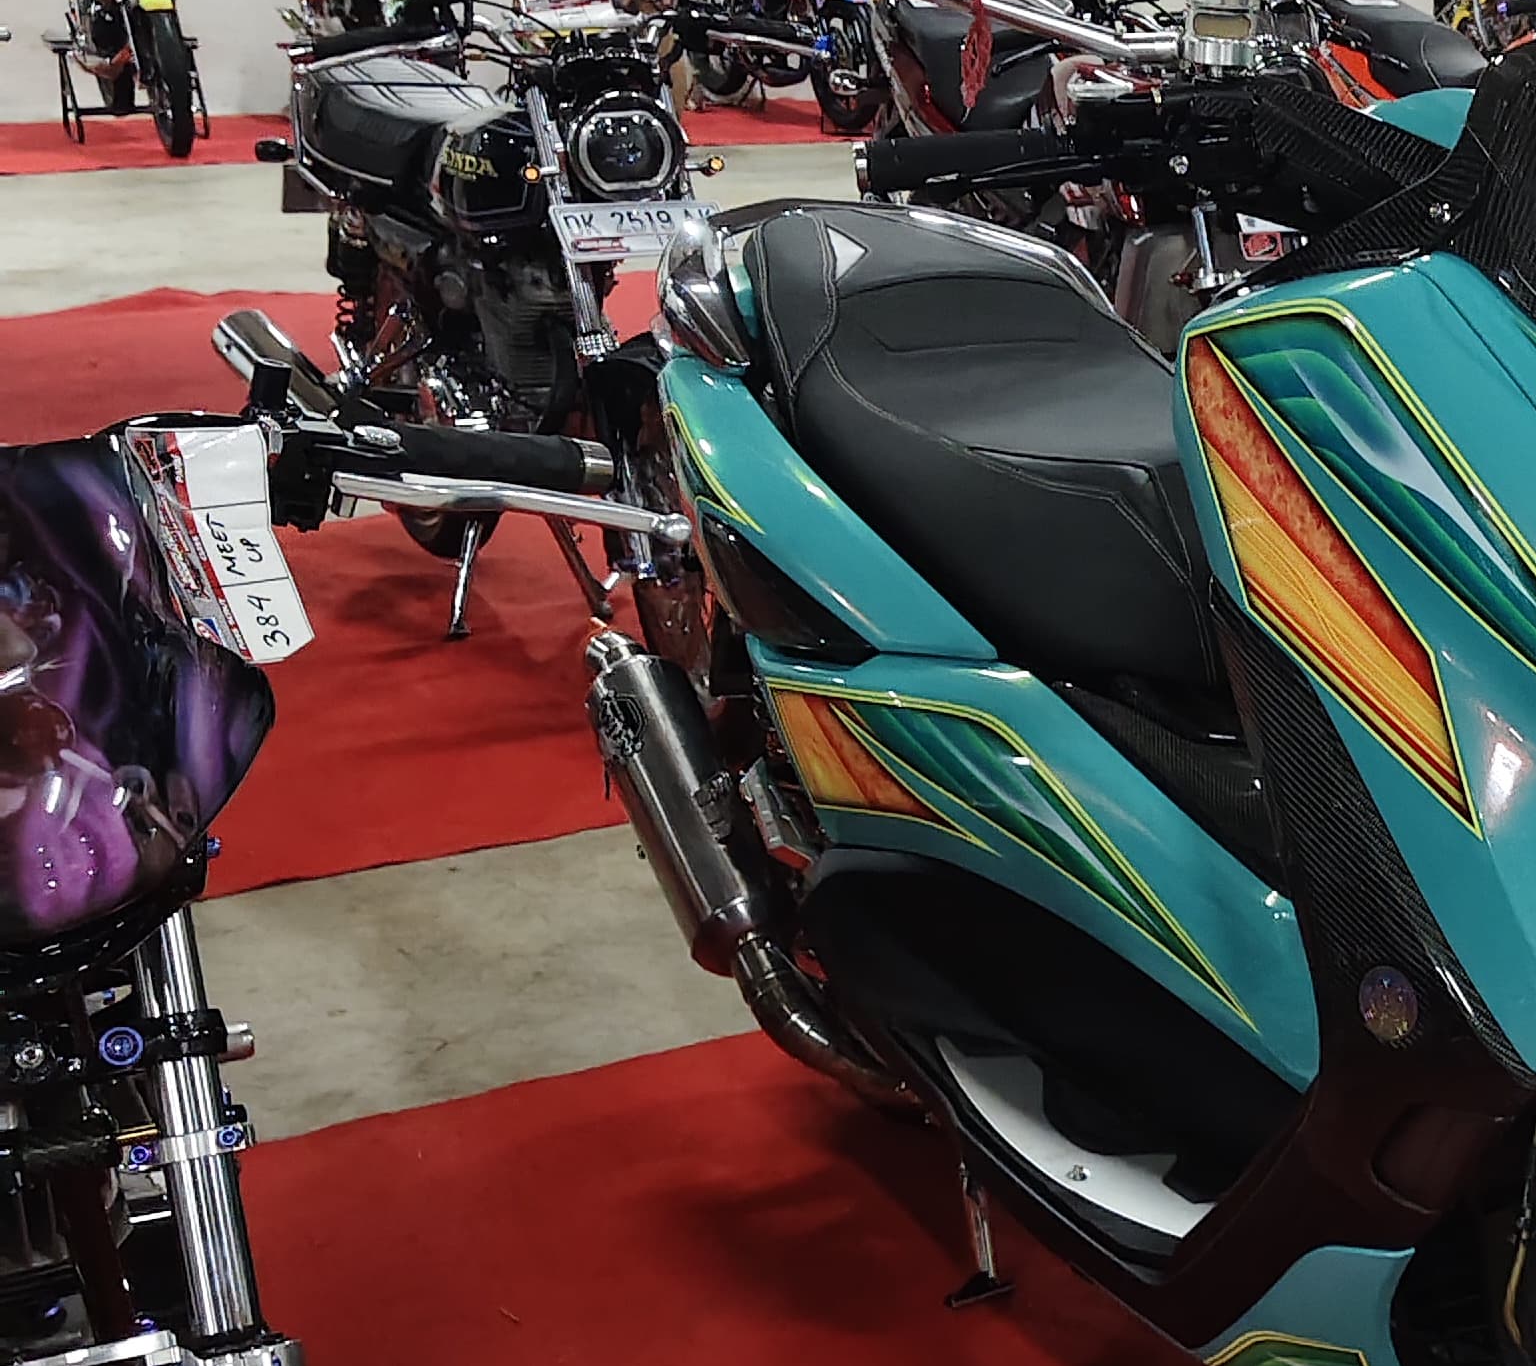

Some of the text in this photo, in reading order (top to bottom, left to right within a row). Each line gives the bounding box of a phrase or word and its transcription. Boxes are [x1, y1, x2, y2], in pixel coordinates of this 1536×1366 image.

[206, 513, 245, 577] MEET
[239, 538, 263, 563] UP
[247, 594, 290, 647] 384
